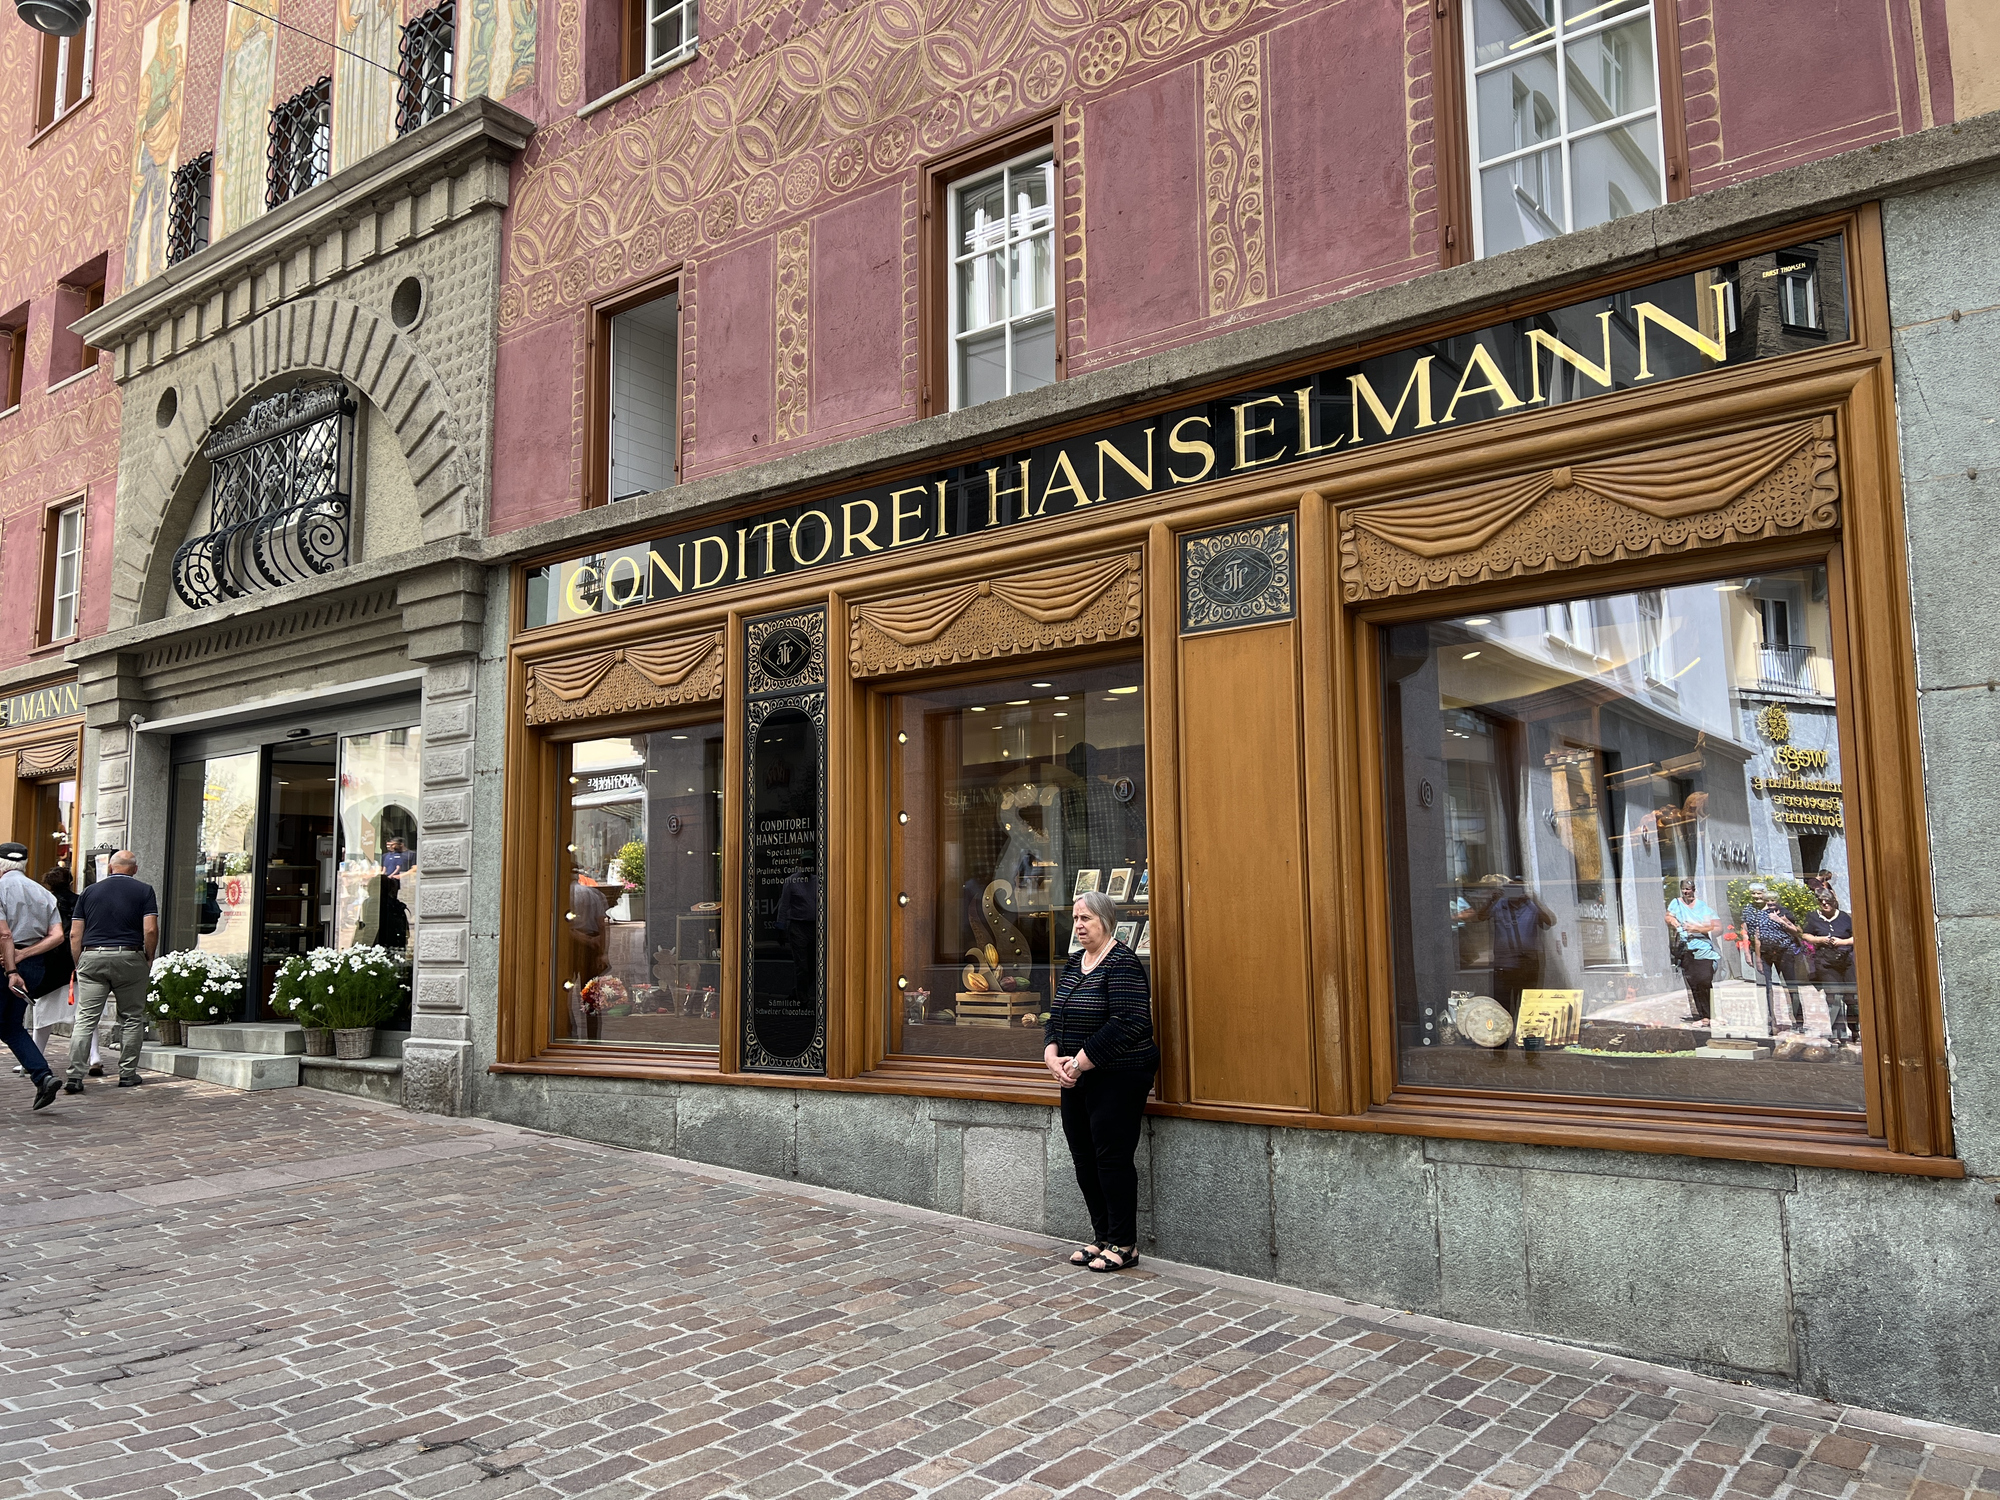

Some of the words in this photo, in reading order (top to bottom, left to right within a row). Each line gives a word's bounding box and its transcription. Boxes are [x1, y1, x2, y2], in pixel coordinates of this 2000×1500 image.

[566, 480, 949, 614] CONDITOREI
[985, 281, 1729, 526] HANSELMANN
[760, 818, 810, 832] CONDITOREI
[756, 830, 815, 846] HANSELMANN
[772, 857, 799, 866] feinster
